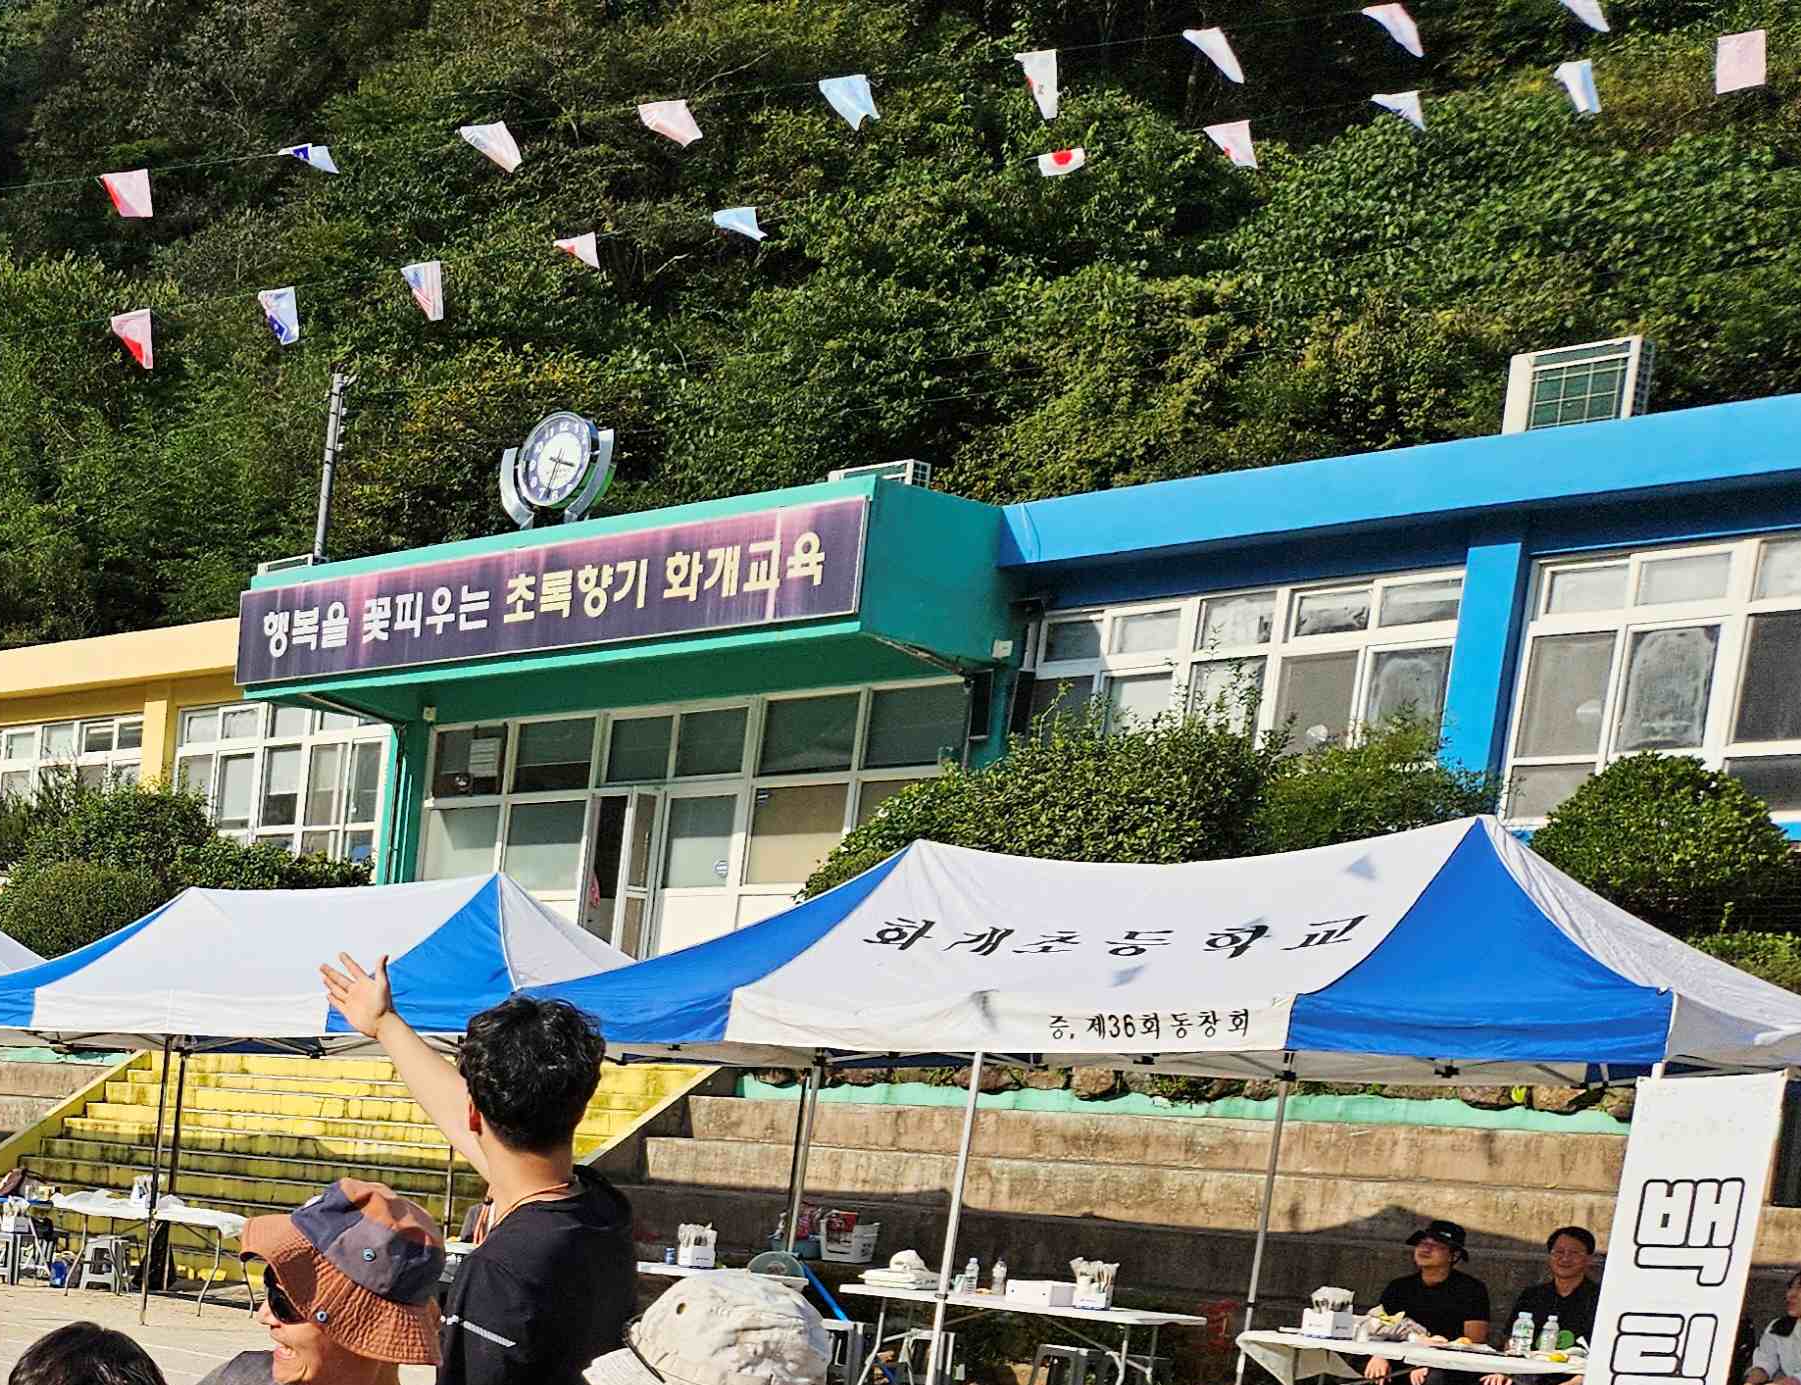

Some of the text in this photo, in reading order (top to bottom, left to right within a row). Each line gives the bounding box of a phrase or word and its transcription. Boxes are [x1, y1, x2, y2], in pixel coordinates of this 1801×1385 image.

[263, 531, 825, 658] 행복을 꽃피우는 초록향기 화개교육
[863, 914, 1369, 960] 화개초등학교
